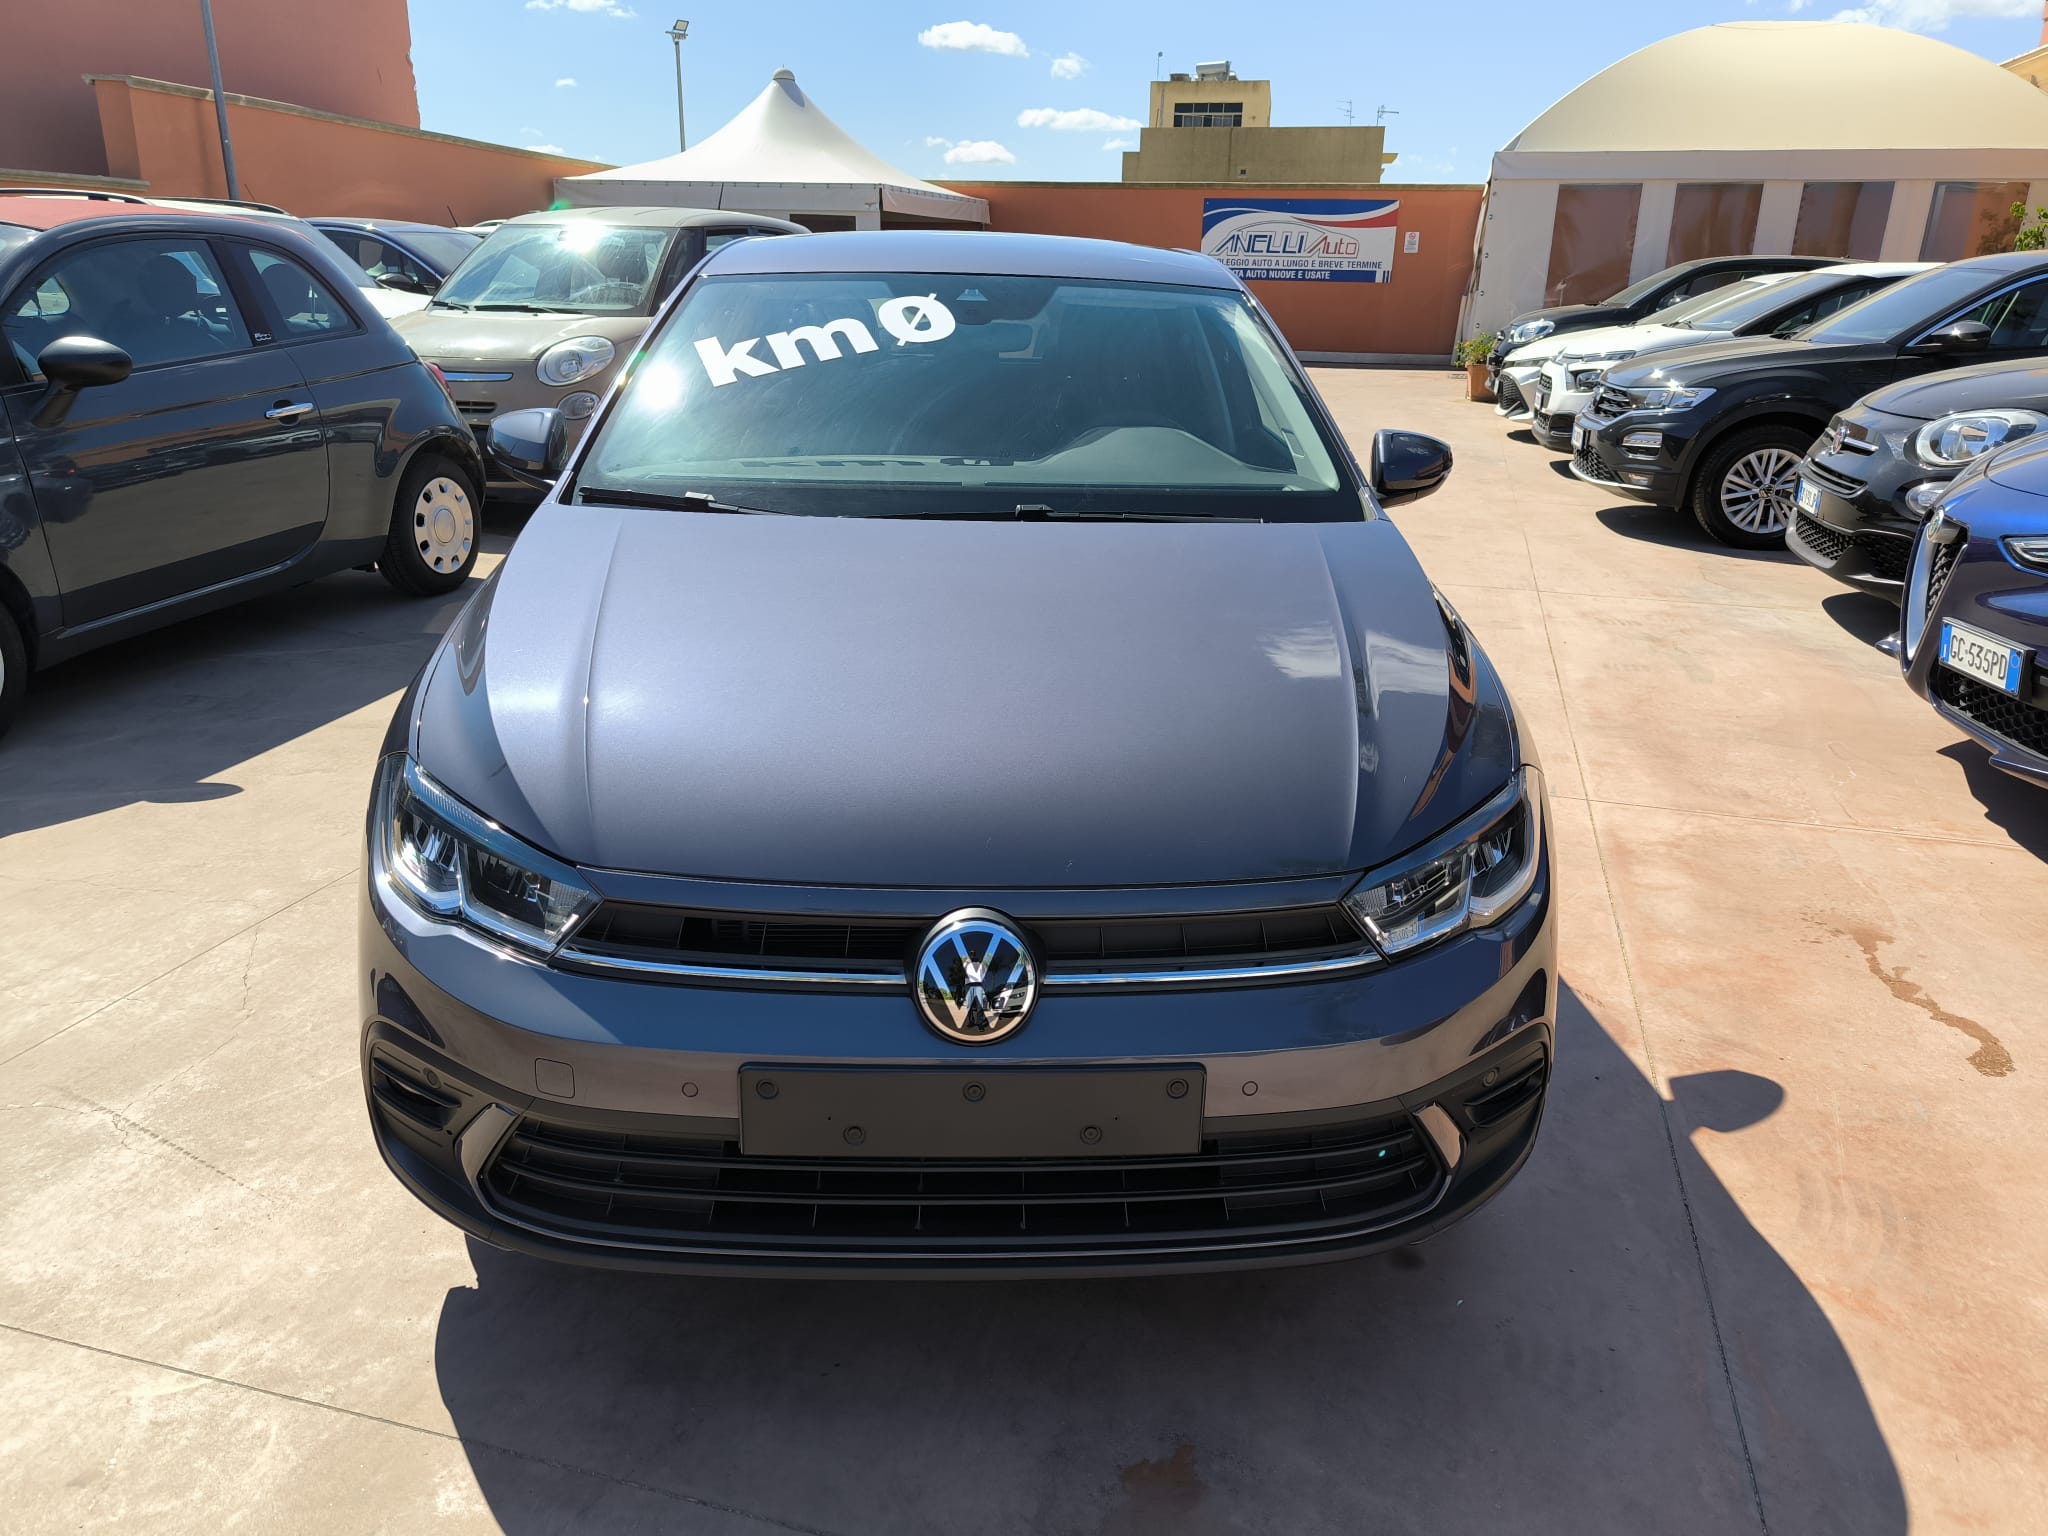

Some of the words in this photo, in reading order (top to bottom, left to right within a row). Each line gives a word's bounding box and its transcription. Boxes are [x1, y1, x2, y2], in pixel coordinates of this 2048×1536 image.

[1251, 259, 1273, 267] AUTO
[1282, 259, 1309, 268] LUNGO
[1311, 260, 1318, 268] E
[1318, 260, 1344, 269] BREVE
[1347, 261, 1383, 270] TERMINE
[1245, 269, 1268, 279] AUTO
[1268, 270, 1297, 279] NUOVE
[1297, 270, 1304, 279] E
[1304, 270, 1331, 280] USATE
